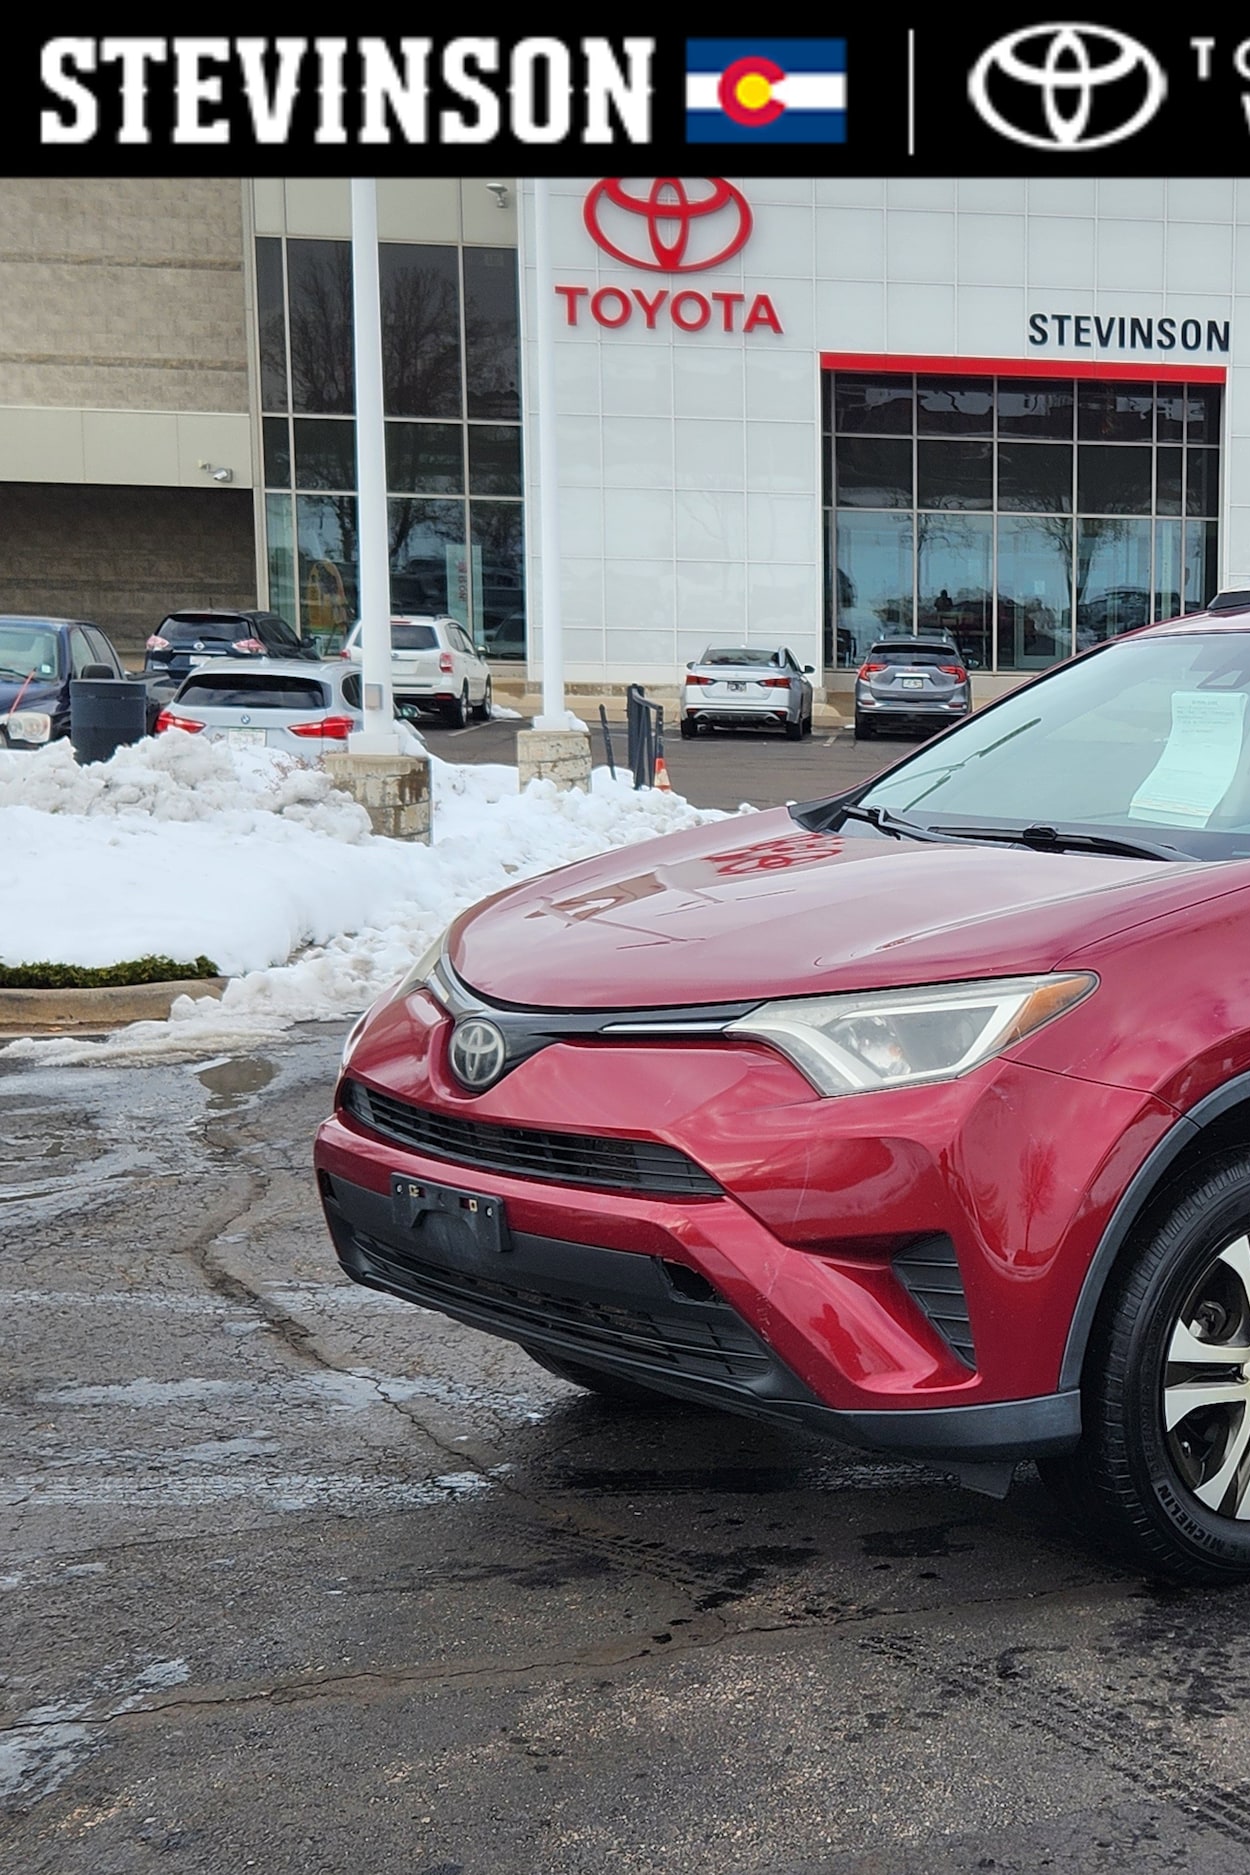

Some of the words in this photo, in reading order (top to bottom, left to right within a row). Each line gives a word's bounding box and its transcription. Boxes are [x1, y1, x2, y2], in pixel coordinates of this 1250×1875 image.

[555, 285, 784, 335] TOYOTA
[1028, 312, 1231, 352] STEVINSON
[1157, 1484, 1227, 1552] MICHELIN
